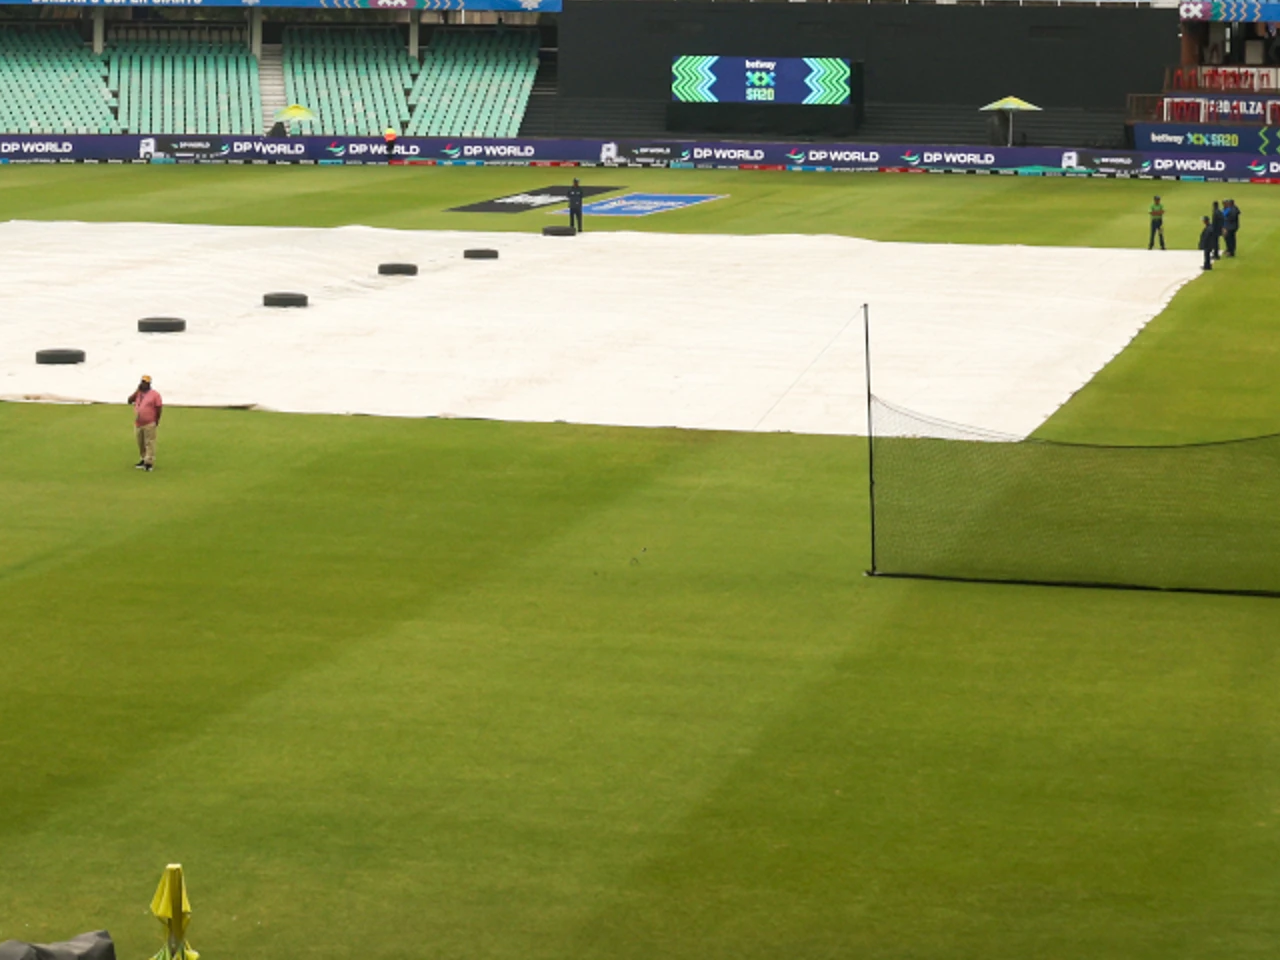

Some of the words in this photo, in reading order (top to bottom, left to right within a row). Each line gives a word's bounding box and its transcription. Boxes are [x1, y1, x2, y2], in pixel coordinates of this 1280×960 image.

[1151, 132, 1183, 146] betway
[0, 142, 21, 153] DP
[22, 142, 73, 153] WORLD
[233, 141, 253, 153] DP
[349, 143, 368, 155] DP
[463, 145, 483, 156] DP
[484, 145, 535, 157] WORLD
[693, 148, 713, 160] DP
[714, 148, 765, 161] WORLD
[809, 149, 829, 162] DP
[830, 150, 880, 162] WORLD
[923, 152, 943, 164] DP
[944, 152, 995, 165] WORLD
[1154, 159, 1174, 171] DP
[1175, 159, 1226, 173] WORLD
